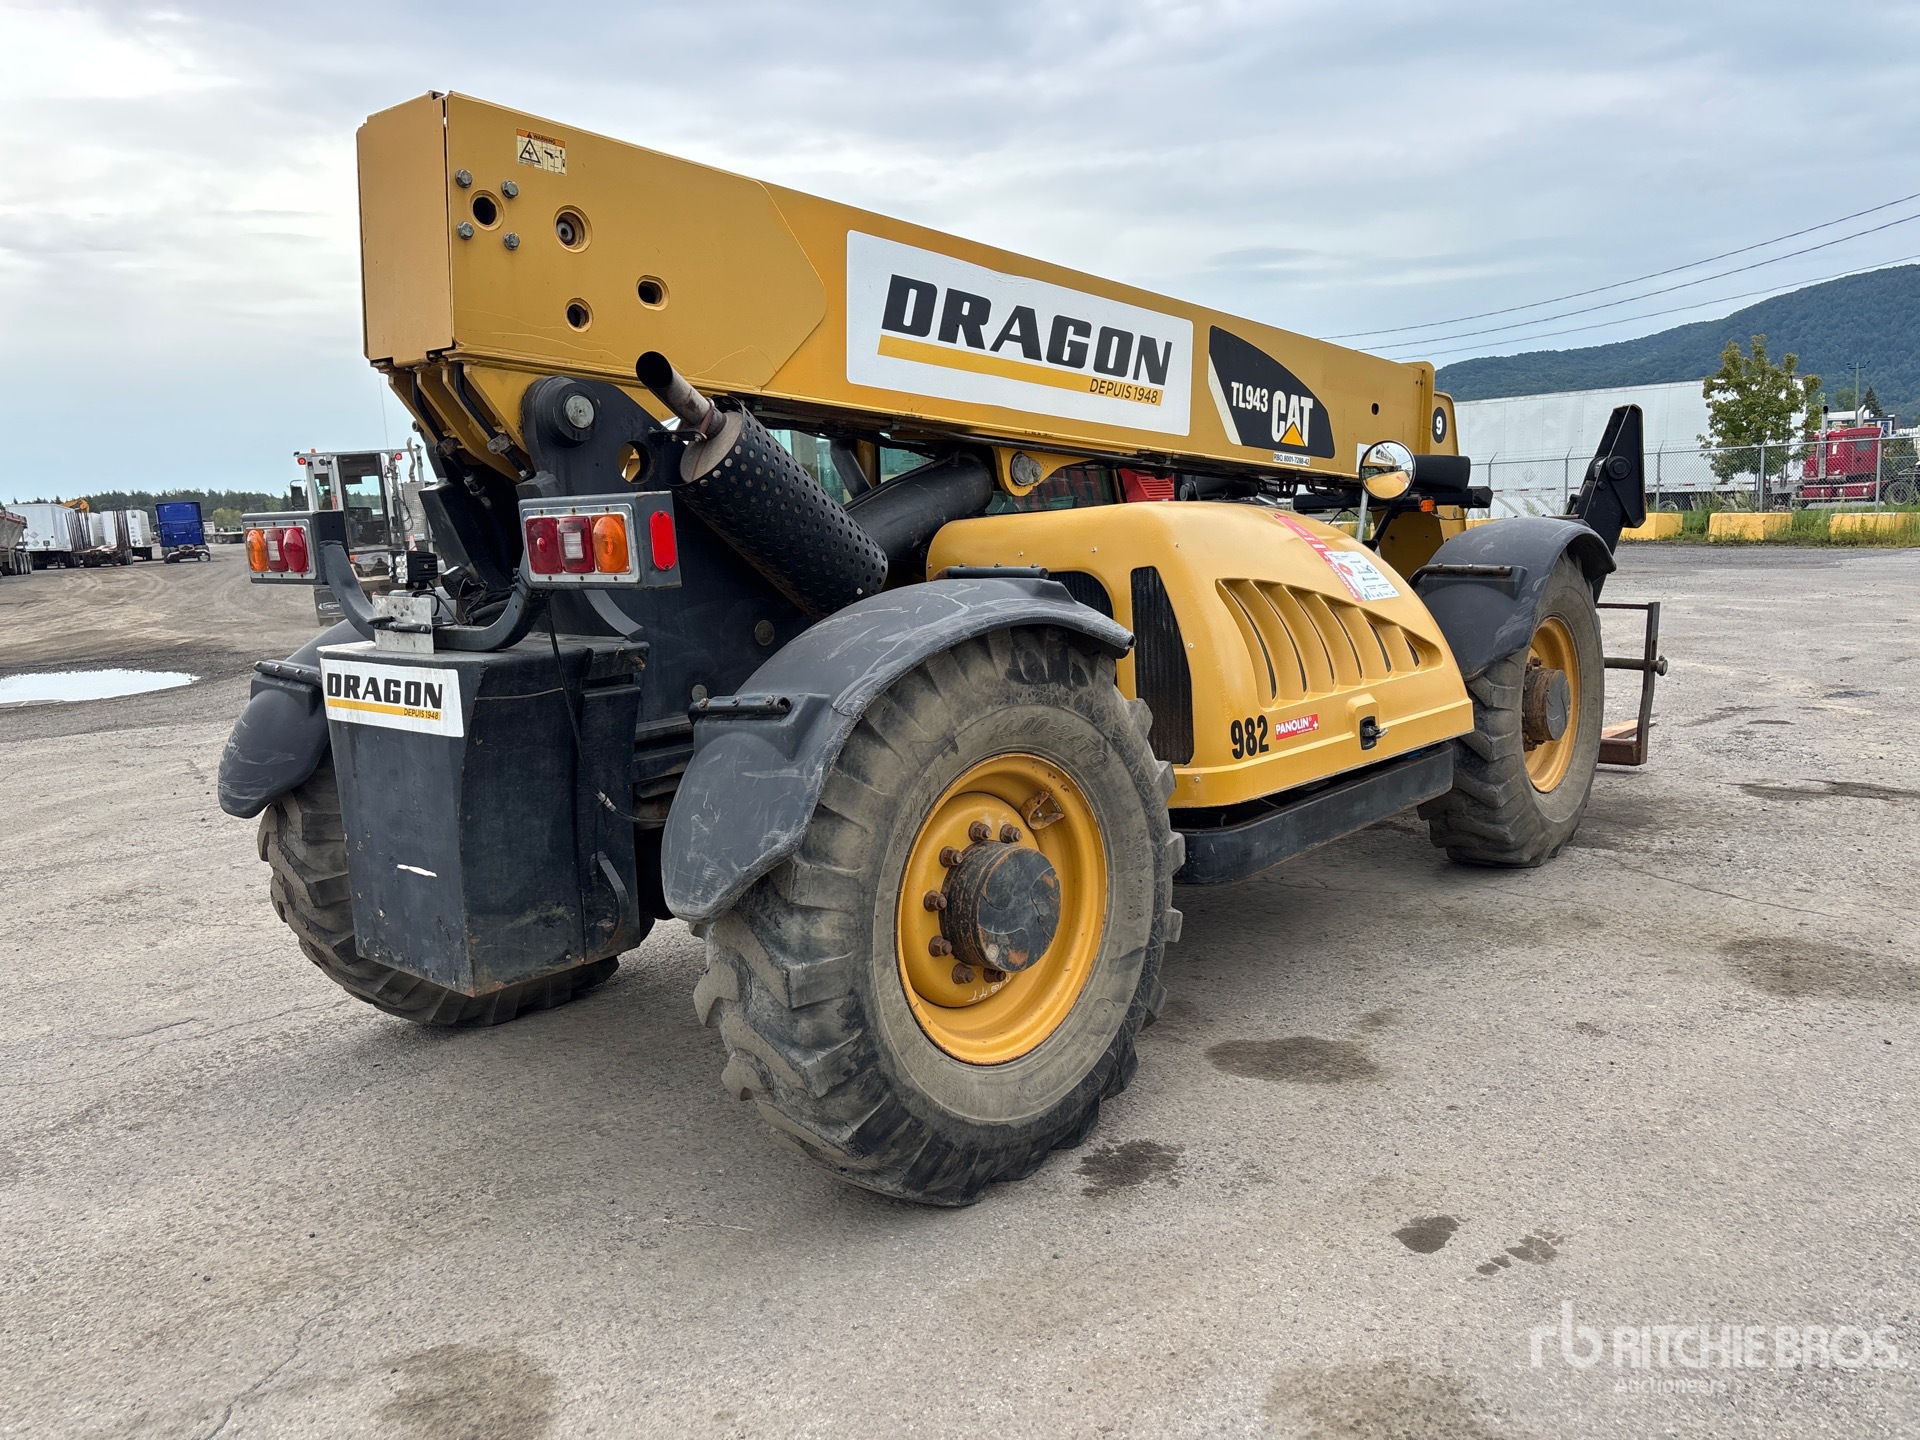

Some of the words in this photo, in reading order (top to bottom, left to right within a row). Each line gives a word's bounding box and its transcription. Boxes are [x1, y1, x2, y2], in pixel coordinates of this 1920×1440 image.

[881, 273, 1173, 386] DRAGON
[1089, 378, 1132, 400] DEPUIS
[1133, 386, 1159, 404] 1948
[1231, 381, 1269, 413] TL943
[1271, 390, 1314, 448] CAT
[1435, 416, 1443, 435] 9
[327, 672, 443, 709] DRAGON
[403, 707, 425, 719] DEPUIS
[425, 710, 439, 720] 1948
[1230, 714, 1270, 760] 982
